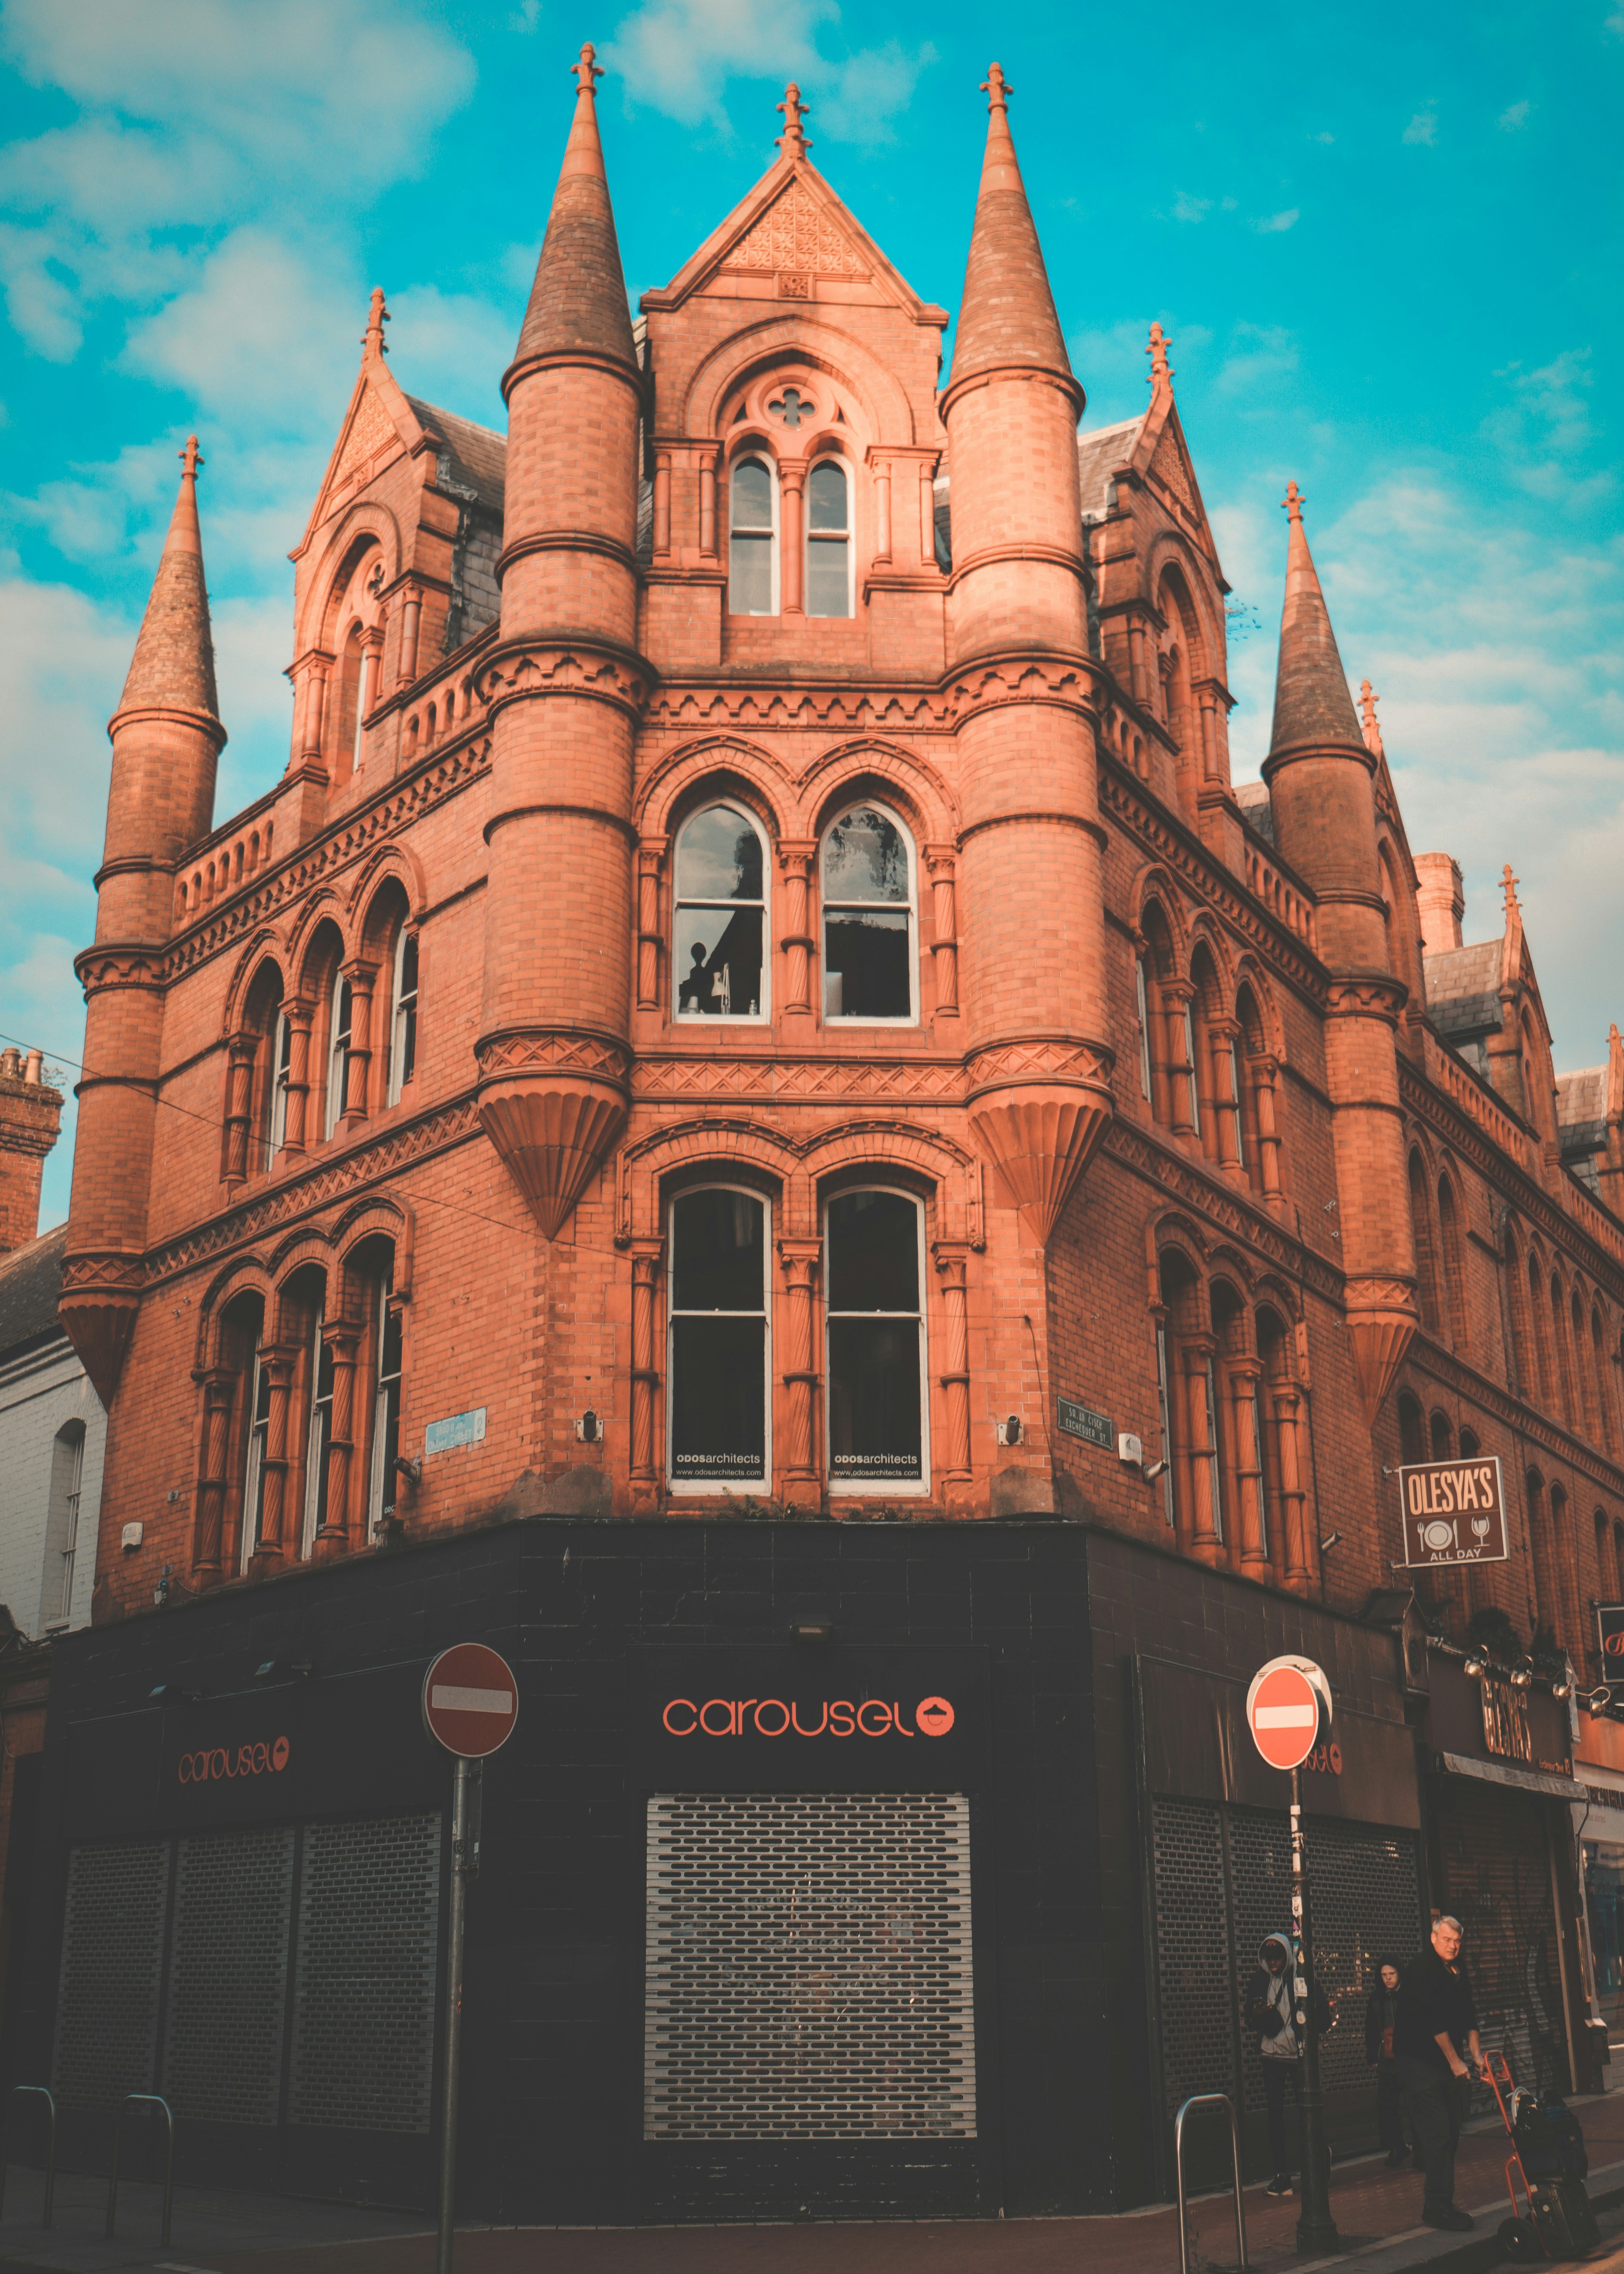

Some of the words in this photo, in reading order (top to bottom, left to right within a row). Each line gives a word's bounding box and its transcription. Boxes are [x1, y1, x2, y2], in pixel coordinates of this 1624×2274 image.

[450, 1429, 472, 1444] STREET
[1066, 1418, 1095, 1438] EXCHEQUER
[1408, 1466, 1493, 1515] OLESYA'S
[1430, 1551, 1453, 1562] ALL
[1457, 1548, 1481, 1559] DAY
[663, 1698, 914, 1737] carousel
[179, 1742, 274, 1784] carousel
